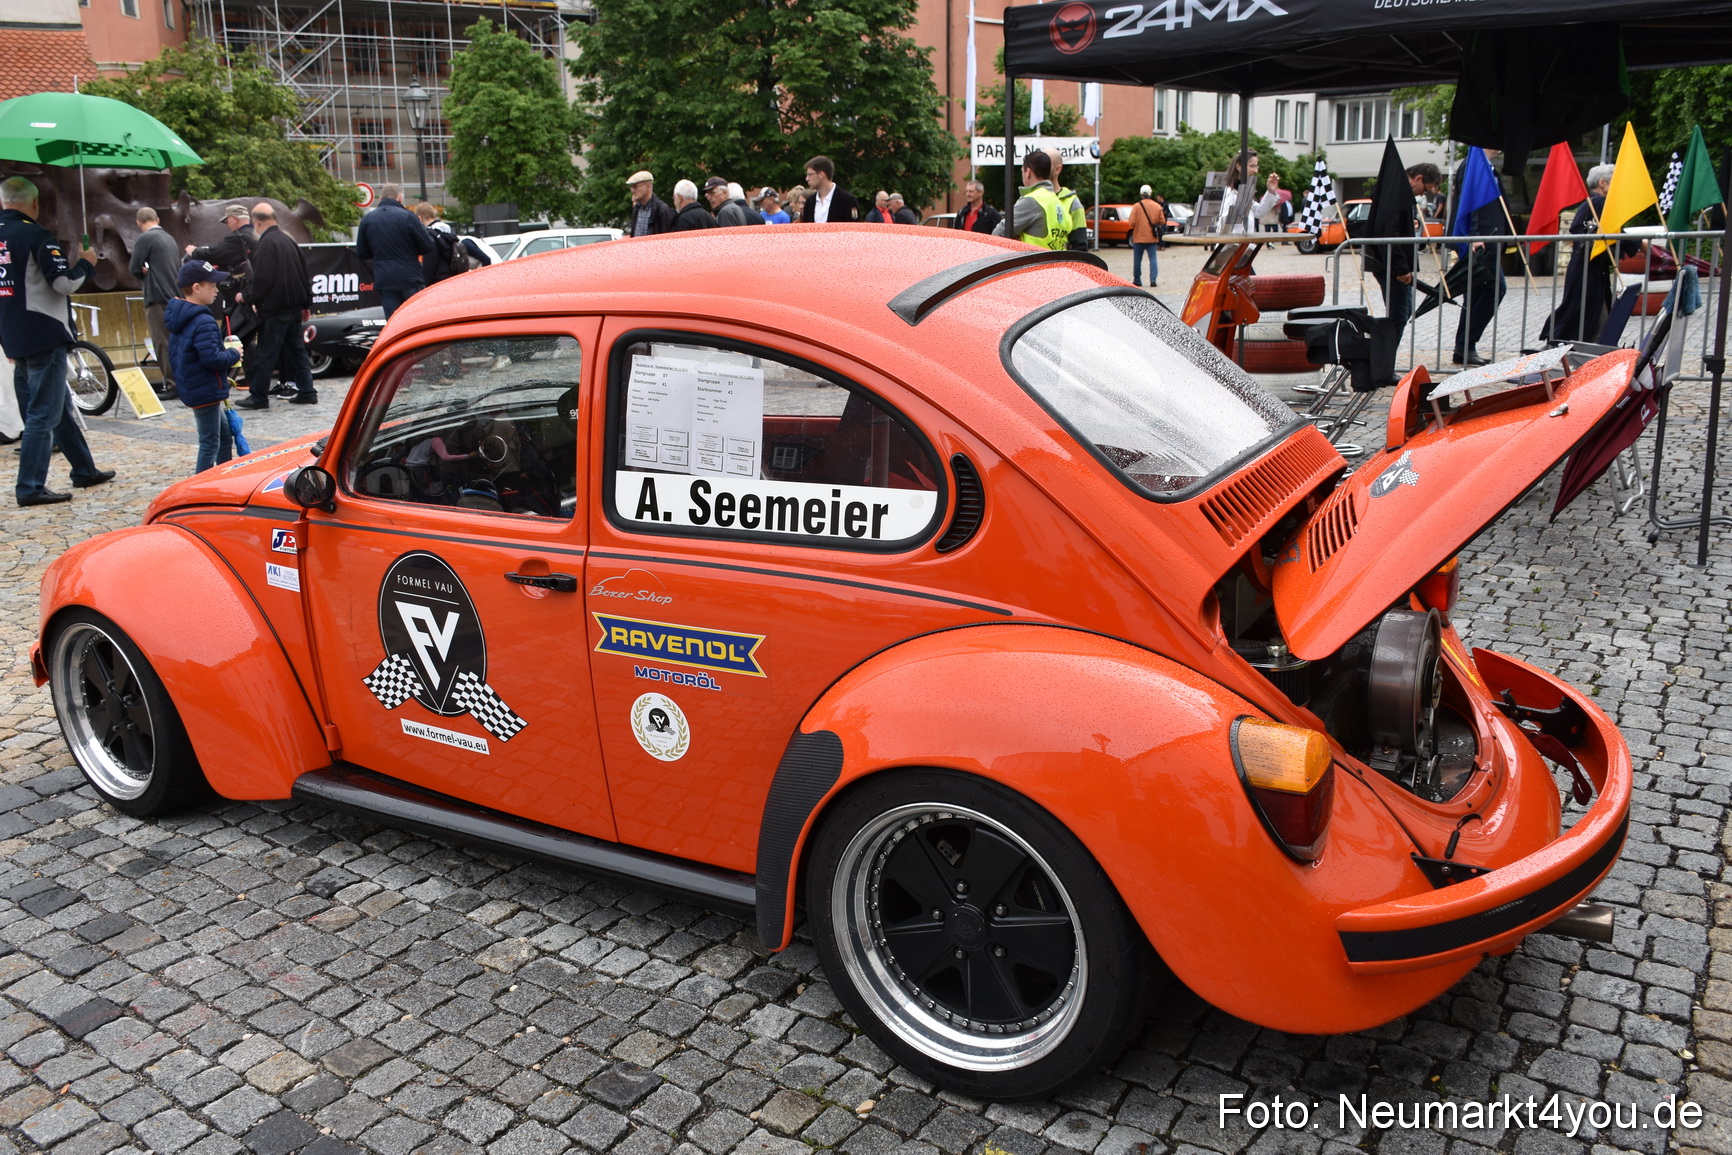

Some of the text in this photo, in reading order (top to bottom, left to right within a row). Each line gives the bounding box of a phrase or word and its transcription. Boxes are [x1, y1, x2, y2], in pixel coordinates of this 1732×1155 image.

[976, 144, 1022, 158] PARL
[634, 476, 889, 540] A. Seemeier
[397, 574, 453, 594] FORMEL VAU
[588, 585, 673, 606] Boxer Shop
[610, 626, 745, 663] RAVENOL
[633, 664, 722, 691] MOTORÖL
[403, 724, 488, 752] www.formel-vau.eu
